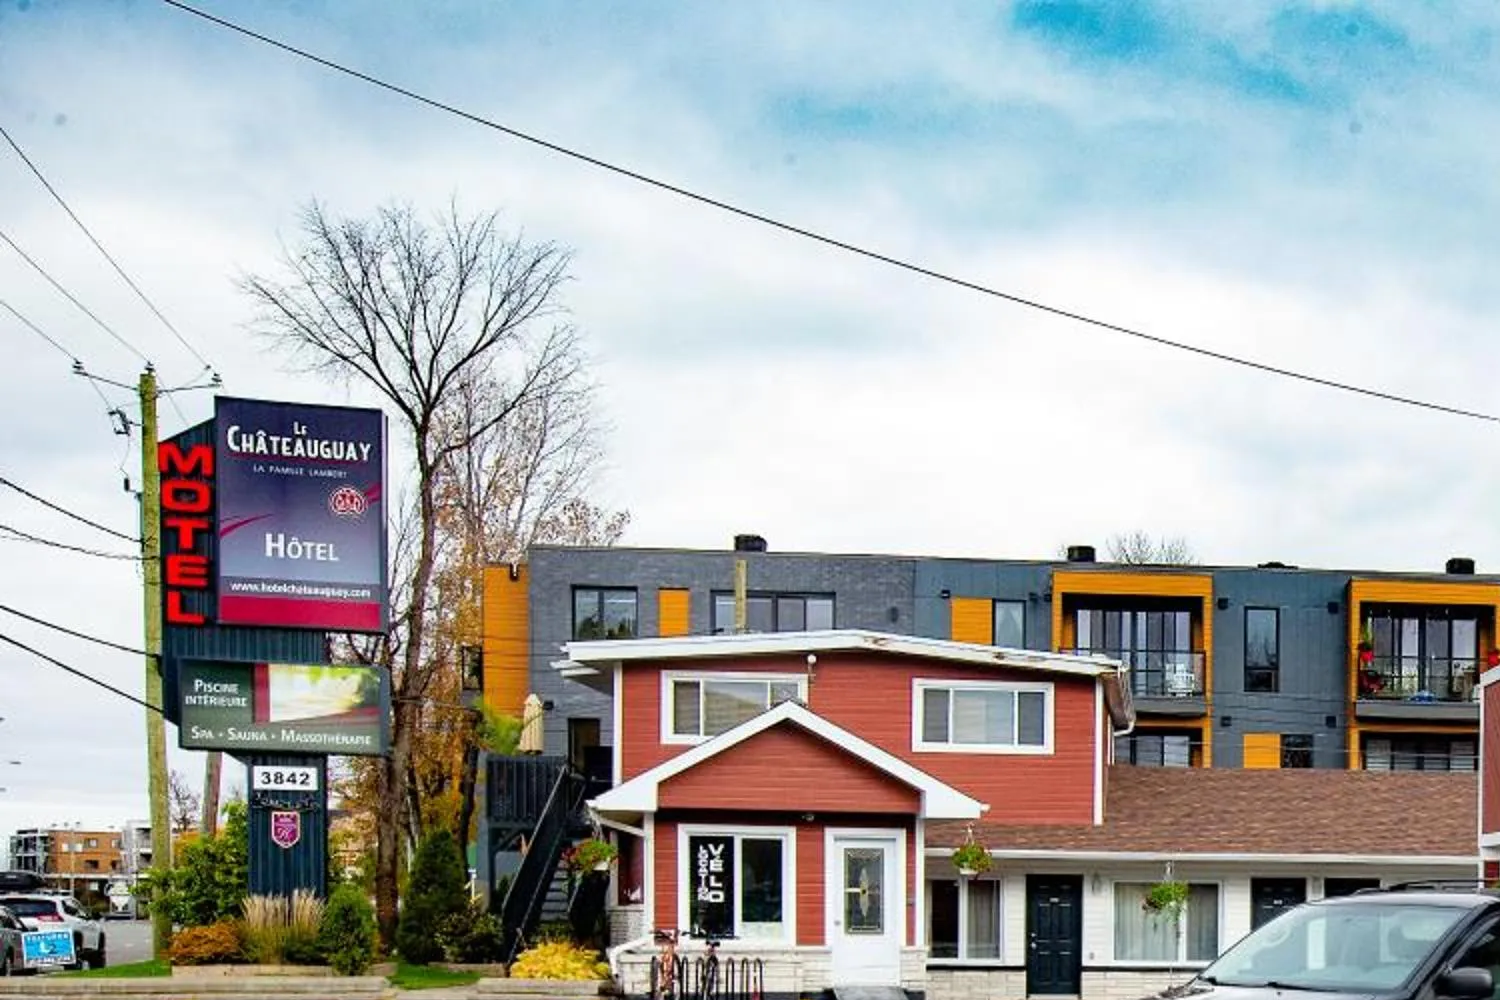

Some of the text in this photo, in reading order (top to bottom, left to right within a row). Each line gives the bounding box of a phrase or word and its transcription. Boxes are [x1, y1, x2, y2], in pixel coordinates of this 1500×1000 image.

[227, 425, 371, 461] CHÂTEAUGUAY
[157, 442, 214, 625] MOTEL
[265, 532, 340, 562] HÔTEL
[194, 679, 239, 694] PISCINE
[191, 725, 215, 740] SPA
[227, 727, 267, 742] SAUNA
[260, 771, 311, 786] 3842
